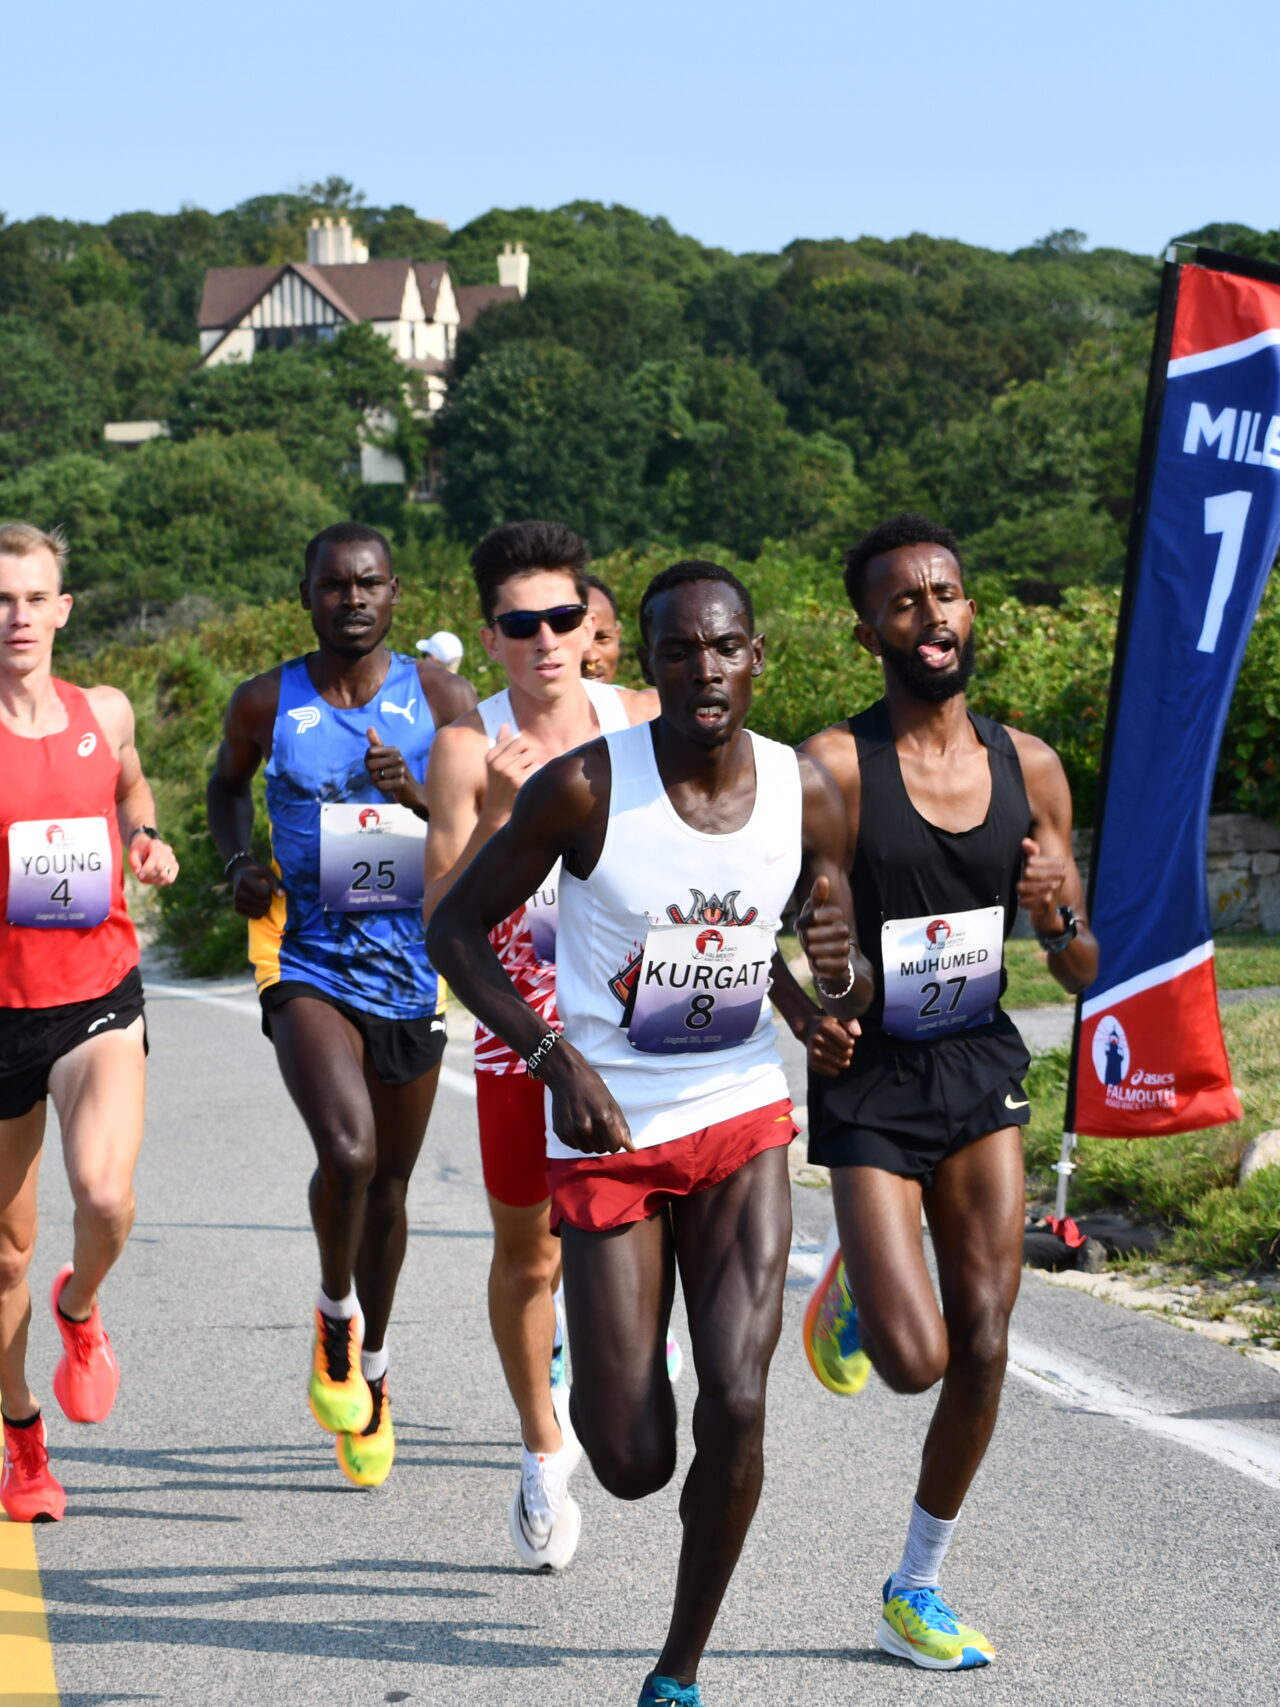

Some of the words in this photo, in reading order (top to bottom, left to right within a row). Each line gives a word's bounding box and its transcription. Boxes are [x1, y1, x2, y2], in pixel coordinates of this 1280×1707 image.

[1183, 402, 1280, 470] MILE
[1196, 490, 1253, 654] 1
[20, 852, 102, 876] YOUNG
[351, 860, 396, 891] 25
[49, 878, 73, 908] 4
[644, 960, 766, 990] KURGAT
[899, 948, 989, 977] MUHUMED
[919, 975, 968, 1018] 27
[685, 994, 716, 1030] 8
[1105, 1083, 1177, 1104] FALMOUTH
[1143, 1072, 1176, 1086] asics
